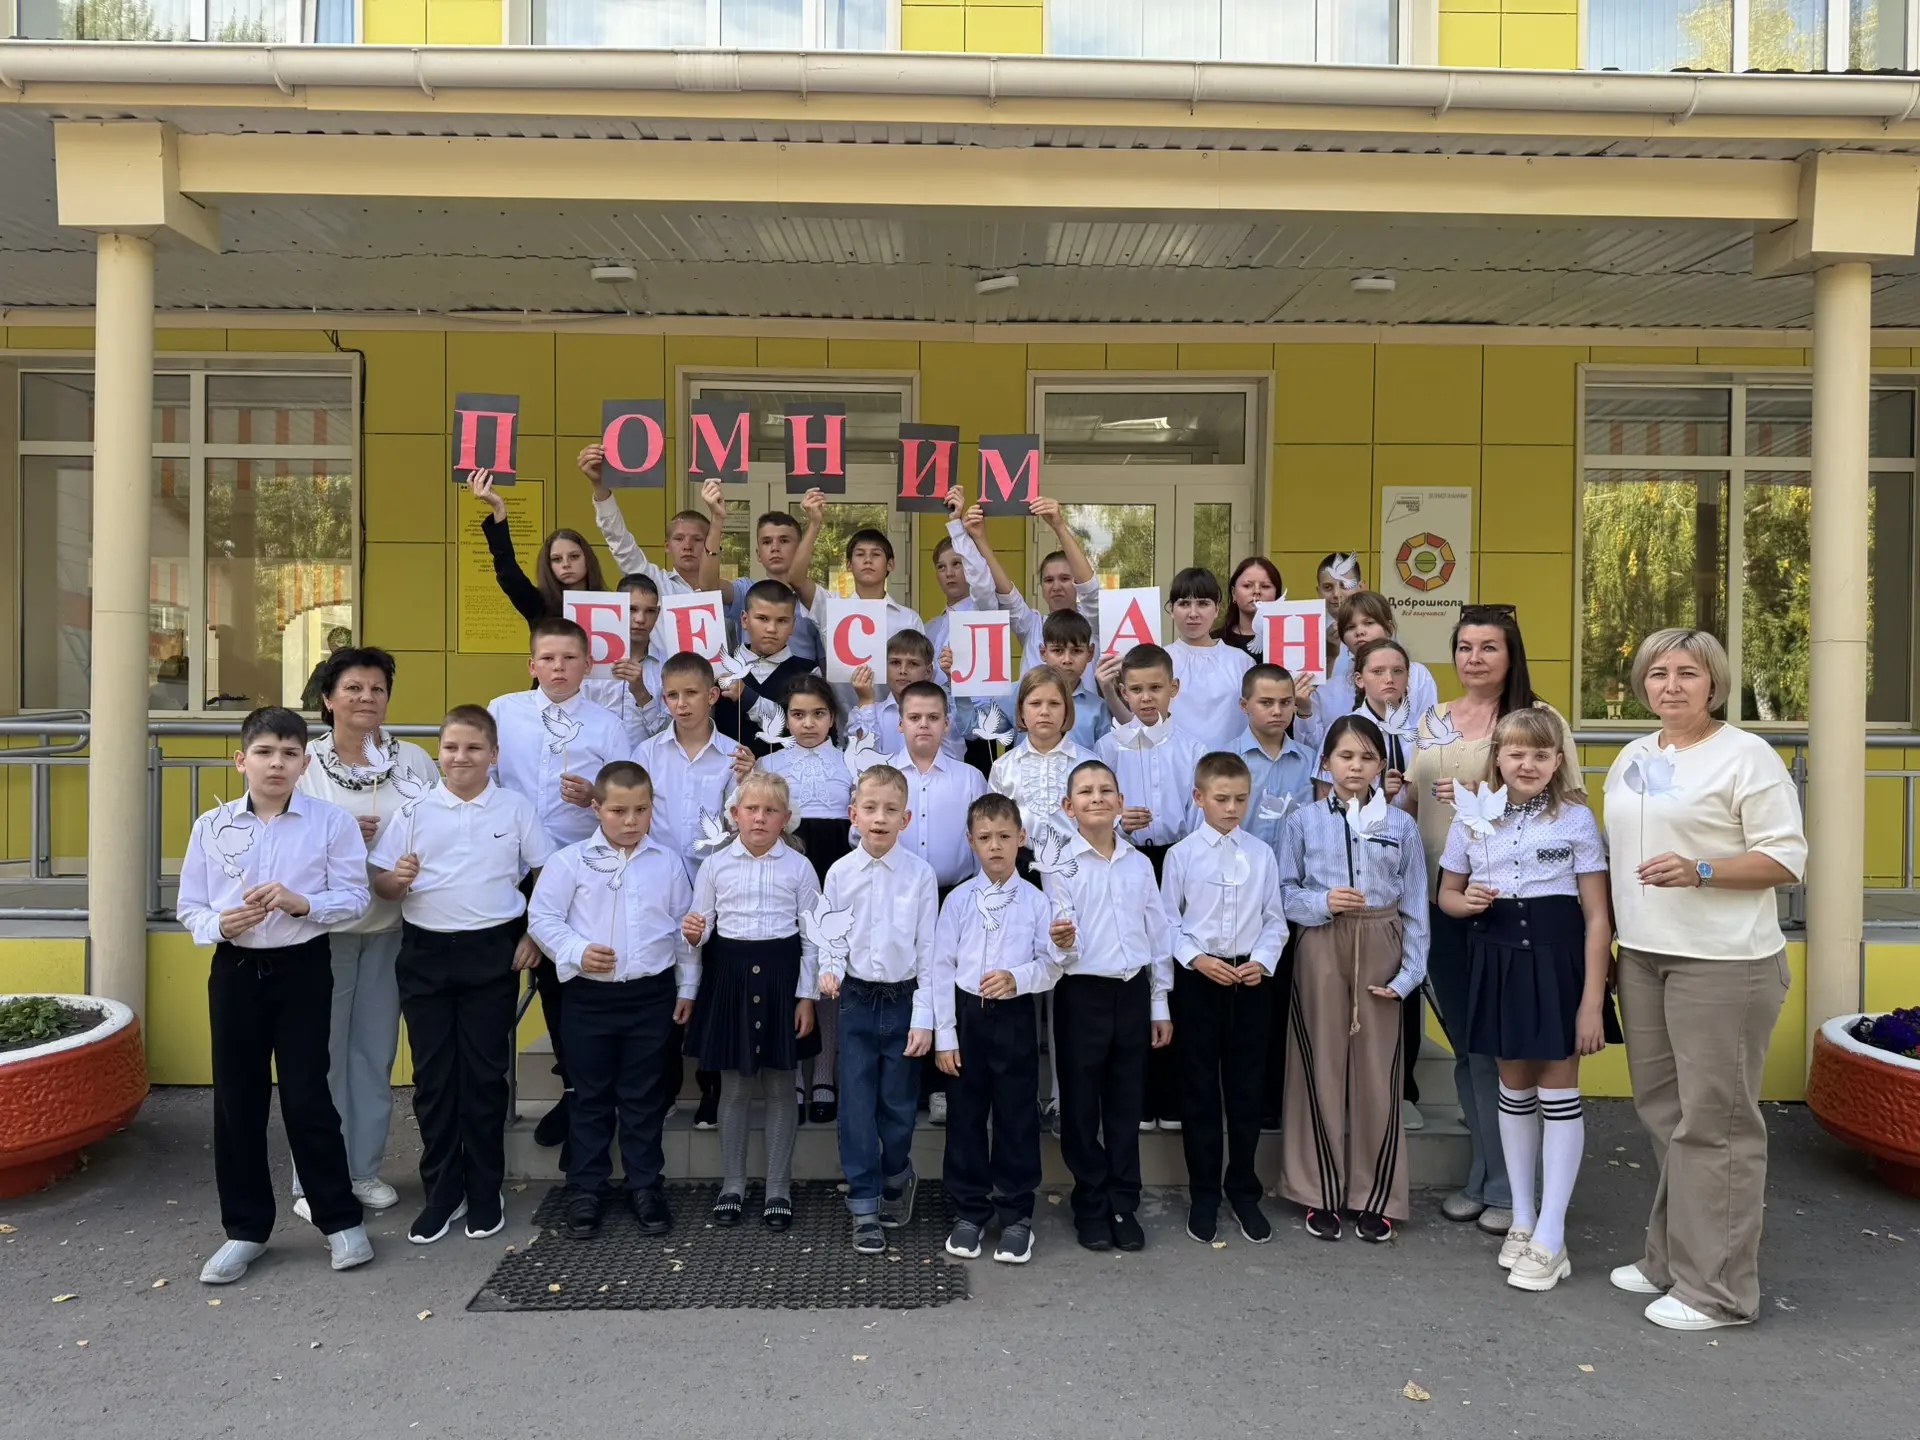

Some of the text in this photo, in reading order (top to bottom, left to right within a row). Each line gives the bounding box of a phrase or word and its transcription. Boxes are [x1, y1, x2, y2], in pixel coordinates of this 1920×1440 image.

[454, 409, 1040, 503] П О М Н И М
[567, 603, 626, 665] Б
[952, 622, 1010, 684] Л
[1263, 612, 1325, 673] Н
[1389, 597, 1463, 609] Доброшкола
